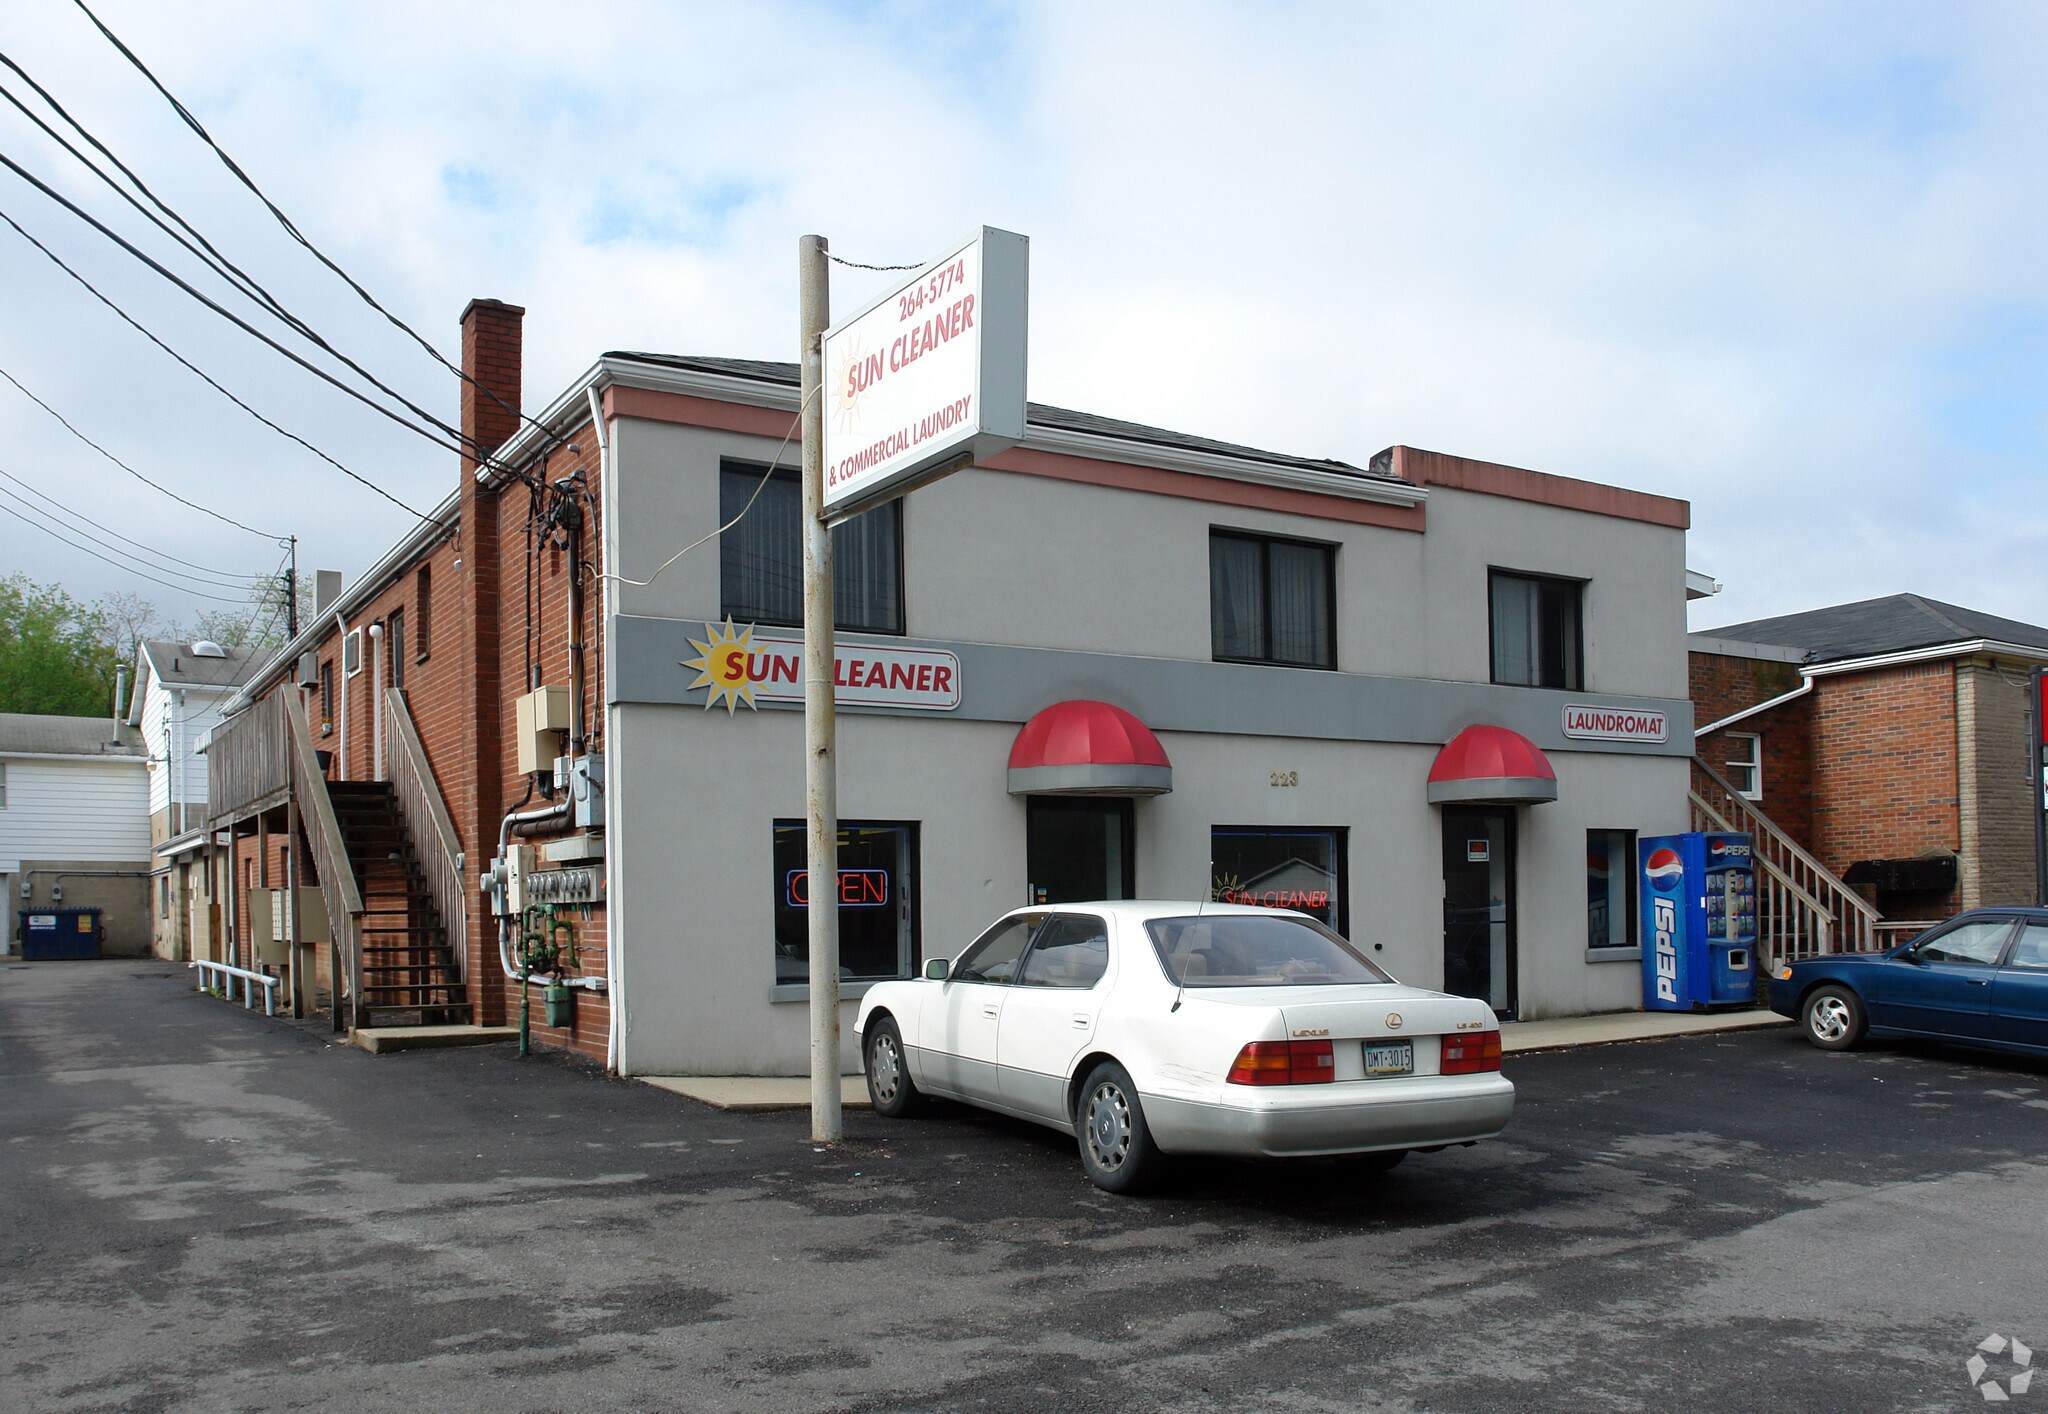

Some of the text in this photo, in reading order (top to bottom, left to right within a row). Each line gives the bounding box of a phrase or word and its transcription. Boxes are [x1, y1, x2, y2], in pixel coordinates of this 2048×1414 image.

[899, 258, 965, 323] 264-5774
[847, 293, 975, 398] SUN CLEANER
[829, 394, 972, 487] & COMMERCIAL LAUNDRY
[723, 651, 952, 693] SUN LEANER
[1567, 711, 1664, 735] LAUNDROMAT
[1270, 770, 1298, 787] 223
[791, 872, 885, 904] OEN
[1224, 889, 1329, 908] SUN CLEANER
[1654, 896, 1677, 1003] PEPSI
[1292, 1028, 1330, 1037] LEXUS
